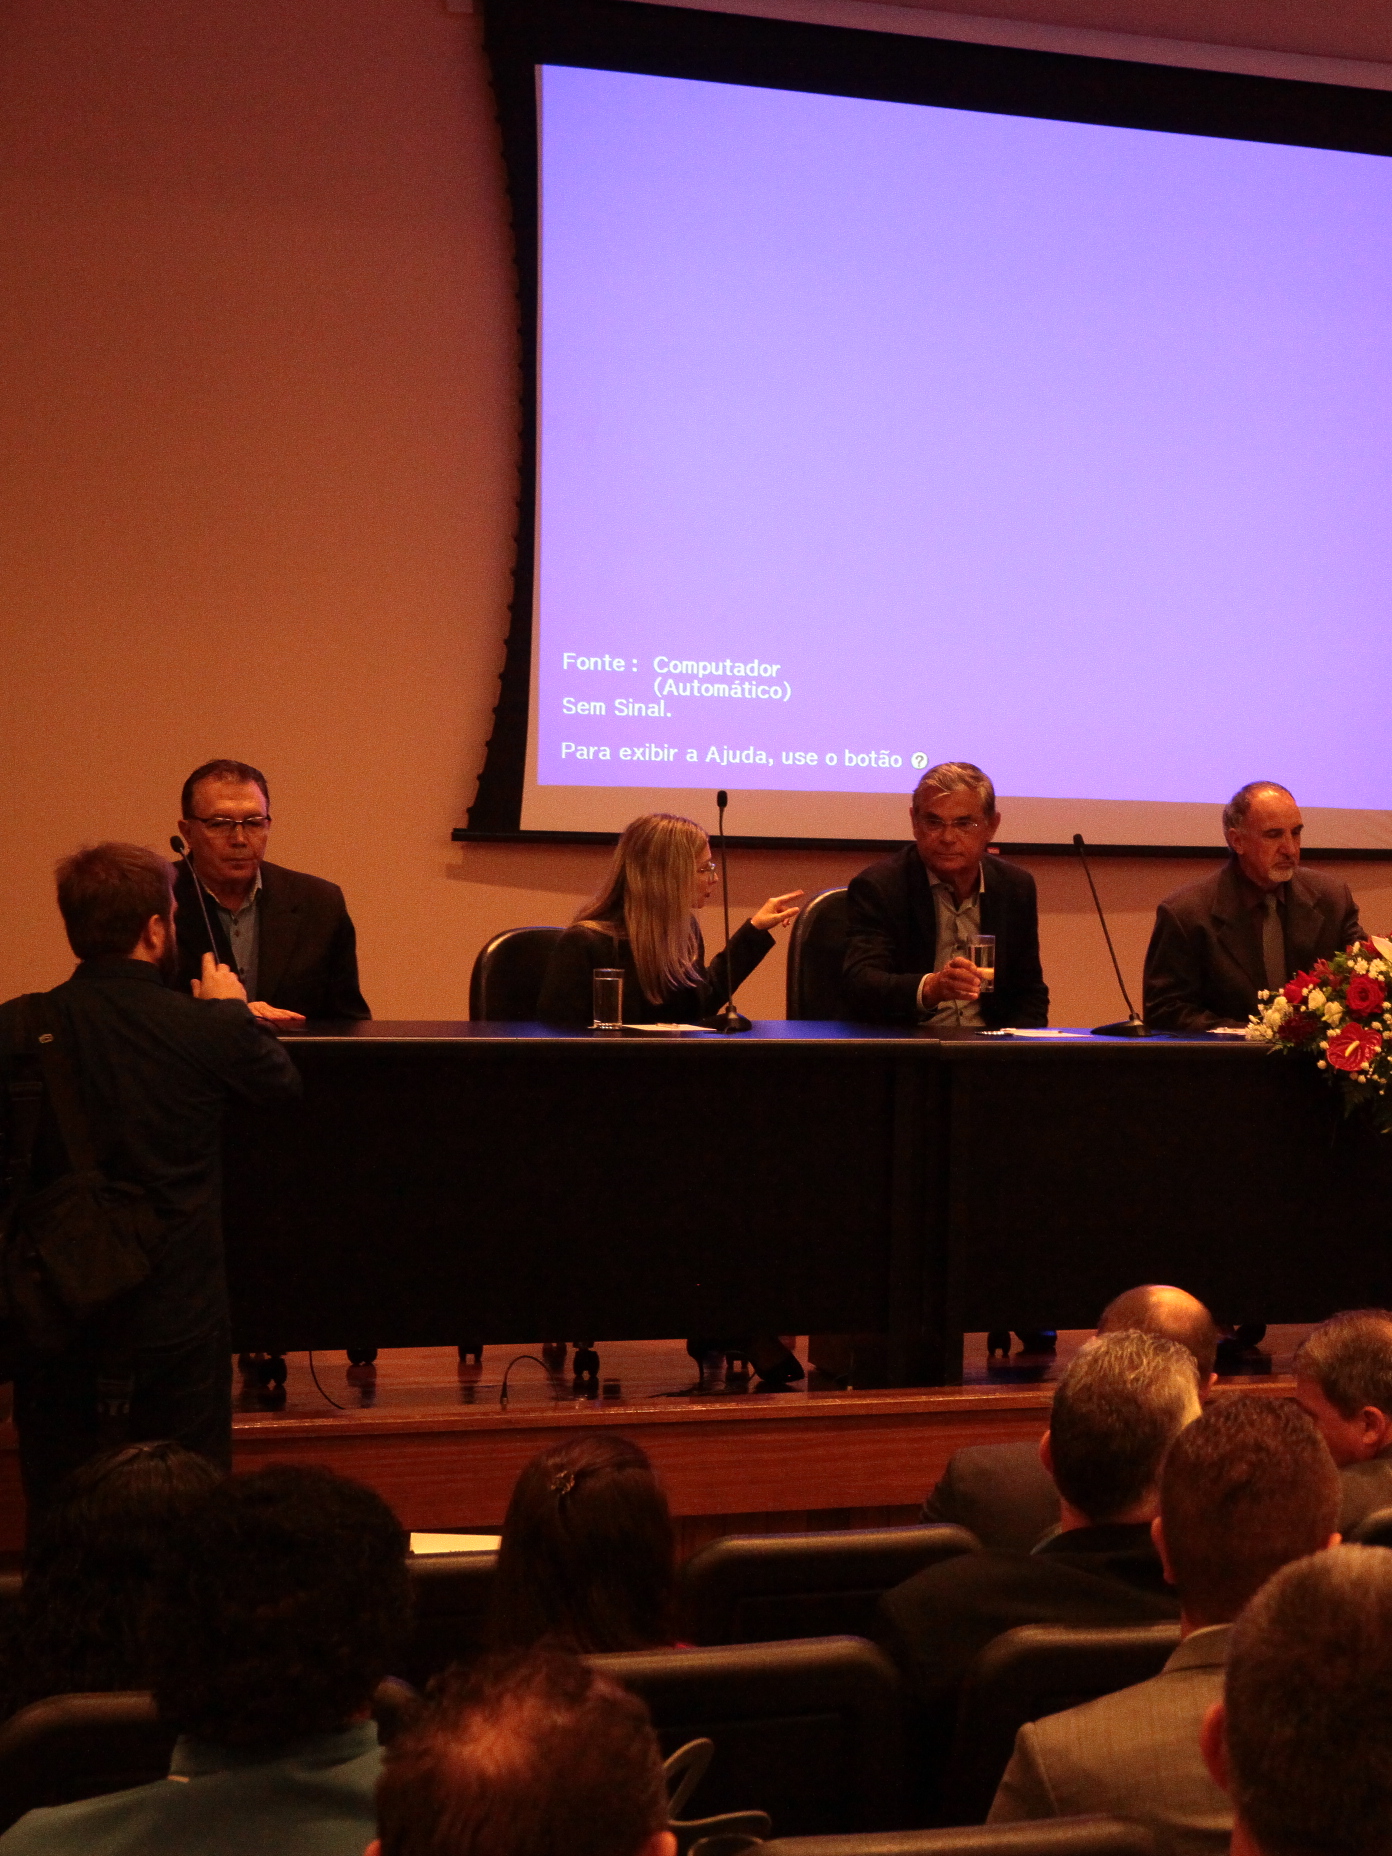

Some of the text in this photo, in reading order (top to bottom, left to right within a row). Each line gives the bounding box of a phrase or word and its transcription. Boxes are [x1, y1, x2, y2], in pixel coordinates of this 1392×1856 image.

[653, 656, 781, 677] Computador
[653, 677, 791, 702] (Automático)
[562, 697, 672, 717] Sem Sinal.
[561, 742, 611, 761] Para
[619, 744, 678, 762] exibir
[686, 749, 698, 762] a
[705, 746, 774, 766] Ajuda,
[781, 752, 818, 766] use
[826, 753, 838, 766] o
[844, 750, 902, 768] botão
